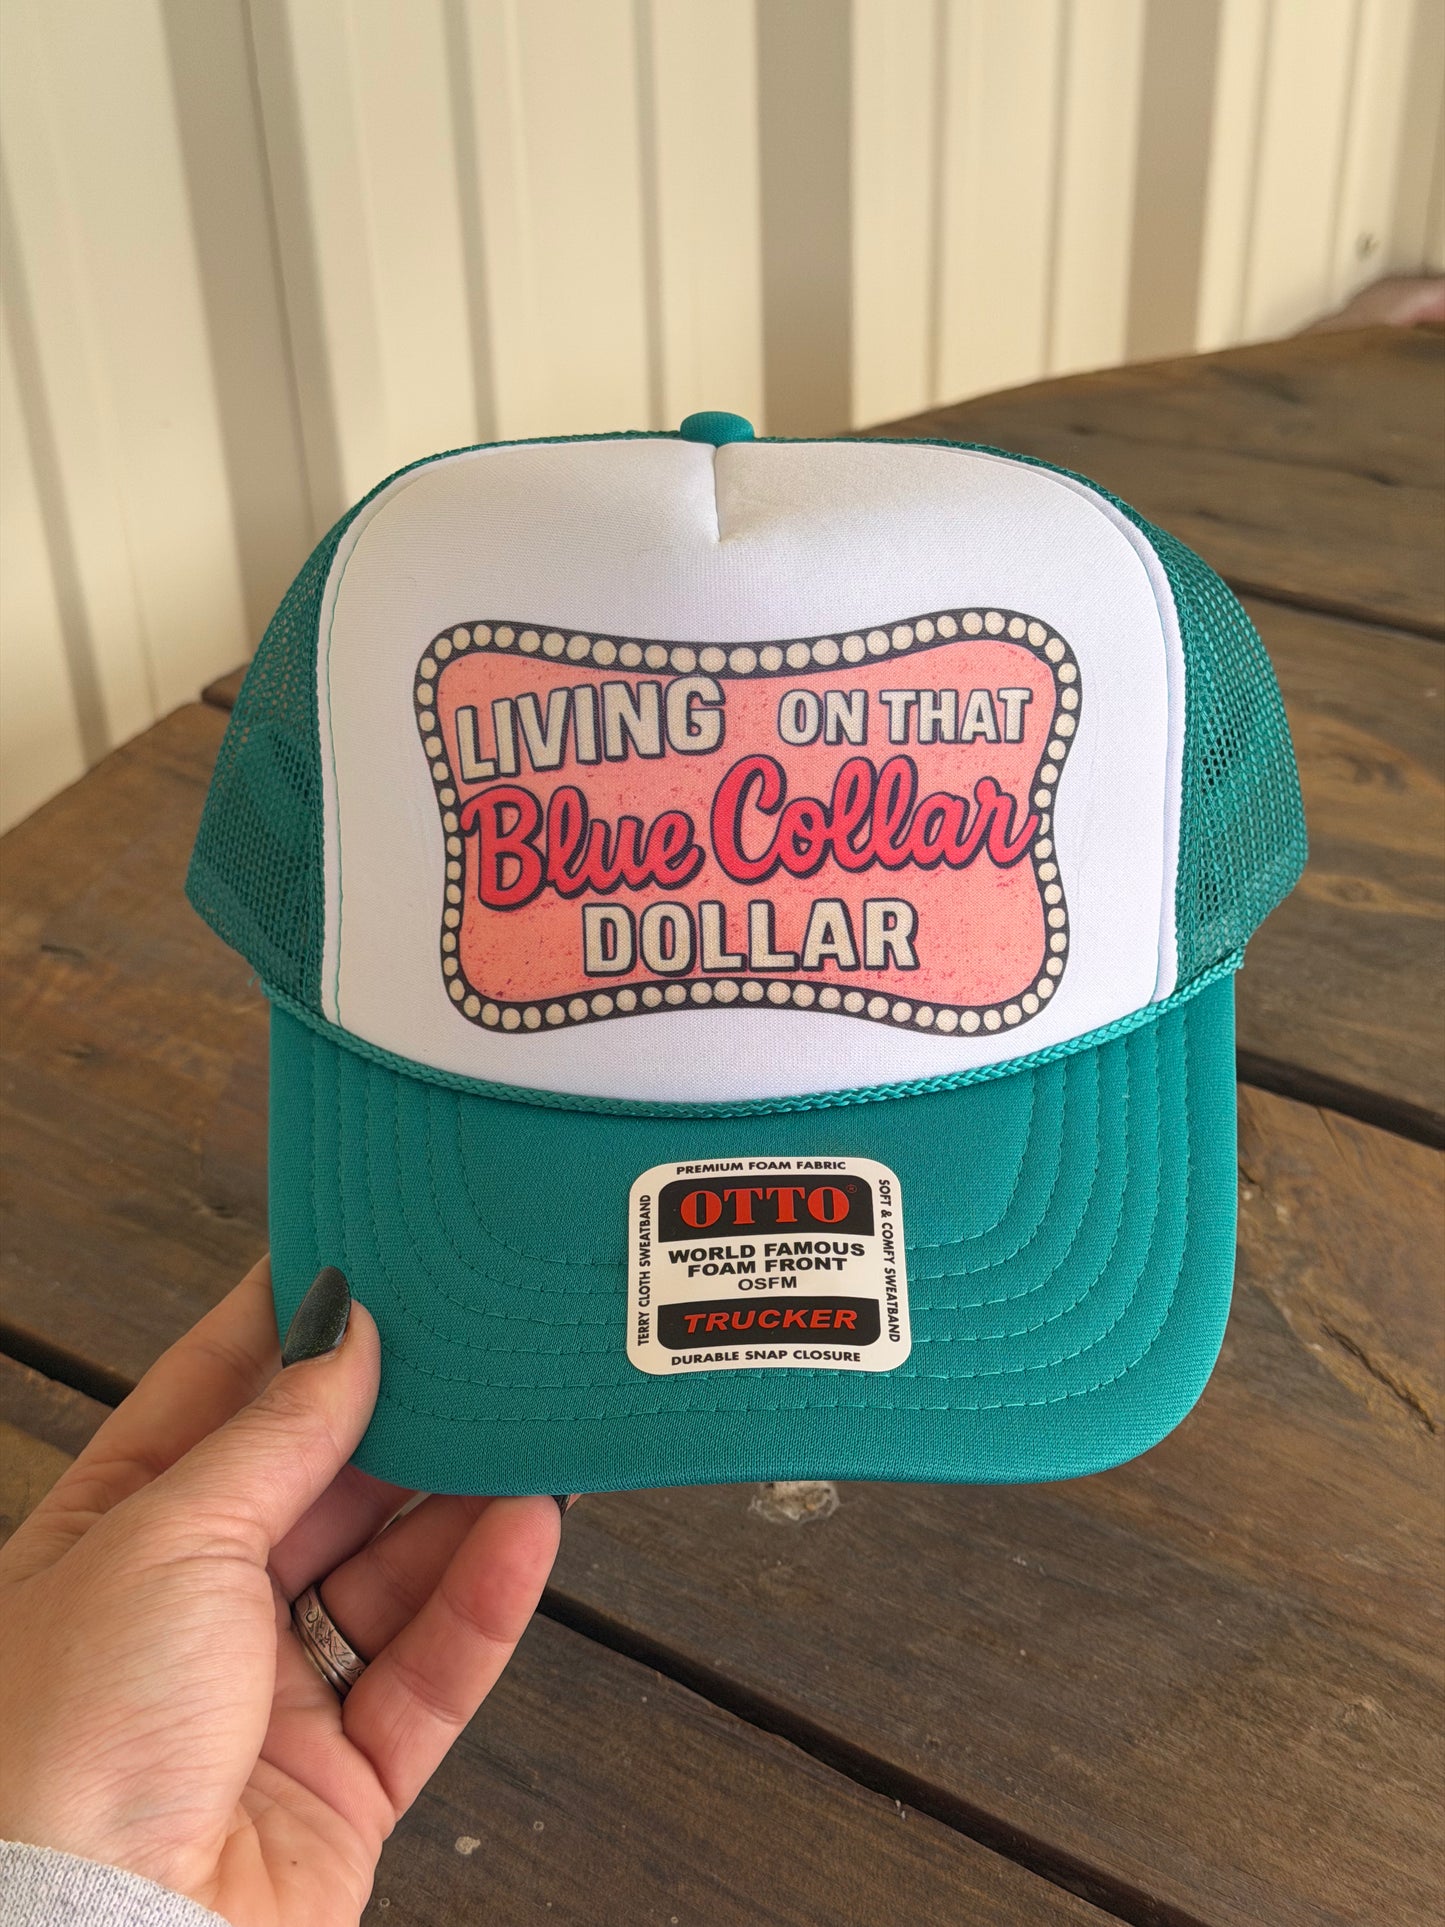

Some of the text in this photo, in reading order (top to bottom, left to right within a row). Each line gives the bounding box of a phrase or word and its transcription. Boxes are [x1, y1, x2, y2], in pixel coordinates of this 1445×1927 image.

[455, 676, 1033, 784] LIVING ON THAT
[460, 754, 1040, 912] Blue Collar
[582, 898, 920, 978] DOLLAR
[676, 1160, 846, 1175] PREMIUM FOAM FABRIC
[668, 1241, 866, 1264] WORLD FAMOUS
[878, 1179, 901, 1342] SOFT & COMFY SWEATBAND
[638, 1194, 651, 1346] TERRY CLOTH SWEATBAND
[687, 1257, 848, 1277] FOAM FRONT
[737, 1276, 797, 1291] OSFM
[683, 1309, 858, 1334] TRUCKER
[671, 1349, 861, 1366] DURABLE SNAP CLOSURE
